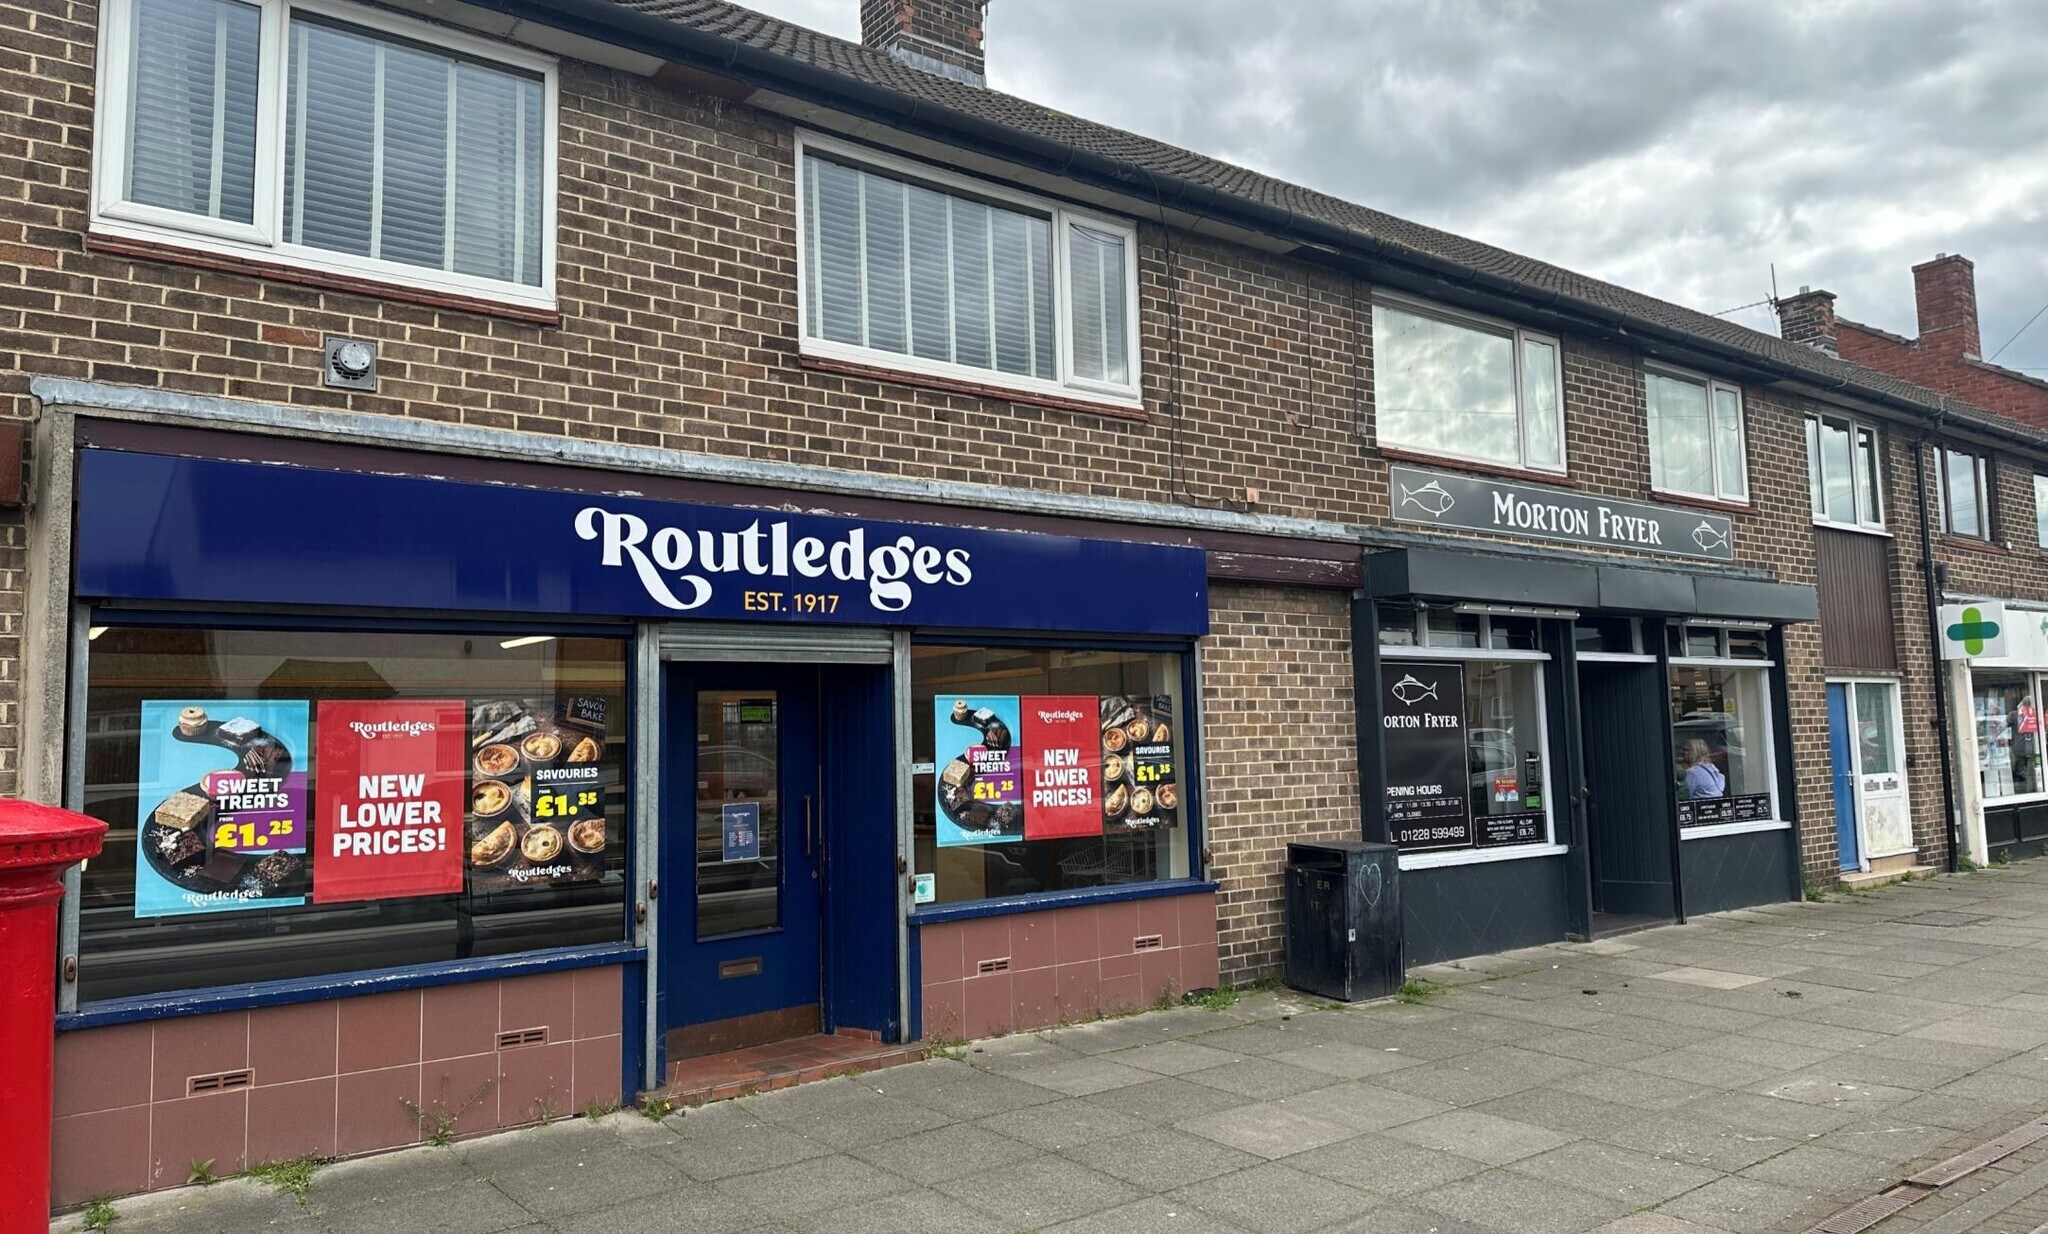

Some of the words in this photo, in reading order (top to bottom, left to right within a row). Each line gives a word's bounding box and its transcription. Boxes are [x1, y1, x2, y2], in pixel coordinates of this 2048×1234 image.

[1492, 491, 1589, 536] MORTON
[1597, 507, 1662, 545] FRYER
[575, 507, 972, 611] Routledges
[744, 591, 787, 613] EST.
[794, 593, 839, 614] 1917
[1037, 710, 1083, 724] Routledges
[1383, 715, 1420, 728] ORTON
[1424, 713, 1459, 728] FRYER
[349, 720, 436, 739] Routledges
[972, 750, 1007, 761] SWEET
[1044, 748, 1079, 767] NEW
[1135, 745, 1171, 755] SAVOURIES
[536, 767, 598, 781] SAVOURIES
[973, 761, 1011, 773] TREATS
[1137, 764, 1171, 782] £1.35
[216, 778, 283, 794] SWEET
[359, 773, 425, 799] NEW
[1035, 768, 1089, 787] LOWER
[973, 781, 1014, 799] £1.25
[1032, 788, 1092, 808] PRICES!
[1386, 786, 1415, 797] PENING
[1416, 784, 1442, 795] HOURS
[216, 793, 289, 810] TREATS
[536, 792, 597, 817] £1.35
[340, 801, 442, 828] LOWER
[215, 820, 293, 848] £1.25
[333, 828, 446, 857] PRICES!
[1401, 828, 1430, 842] 01228
[1431, 826, 1465, 840] 599499
[508, 865, 572, 882] Routledges
[182, 888, 263, 907] Routledges
